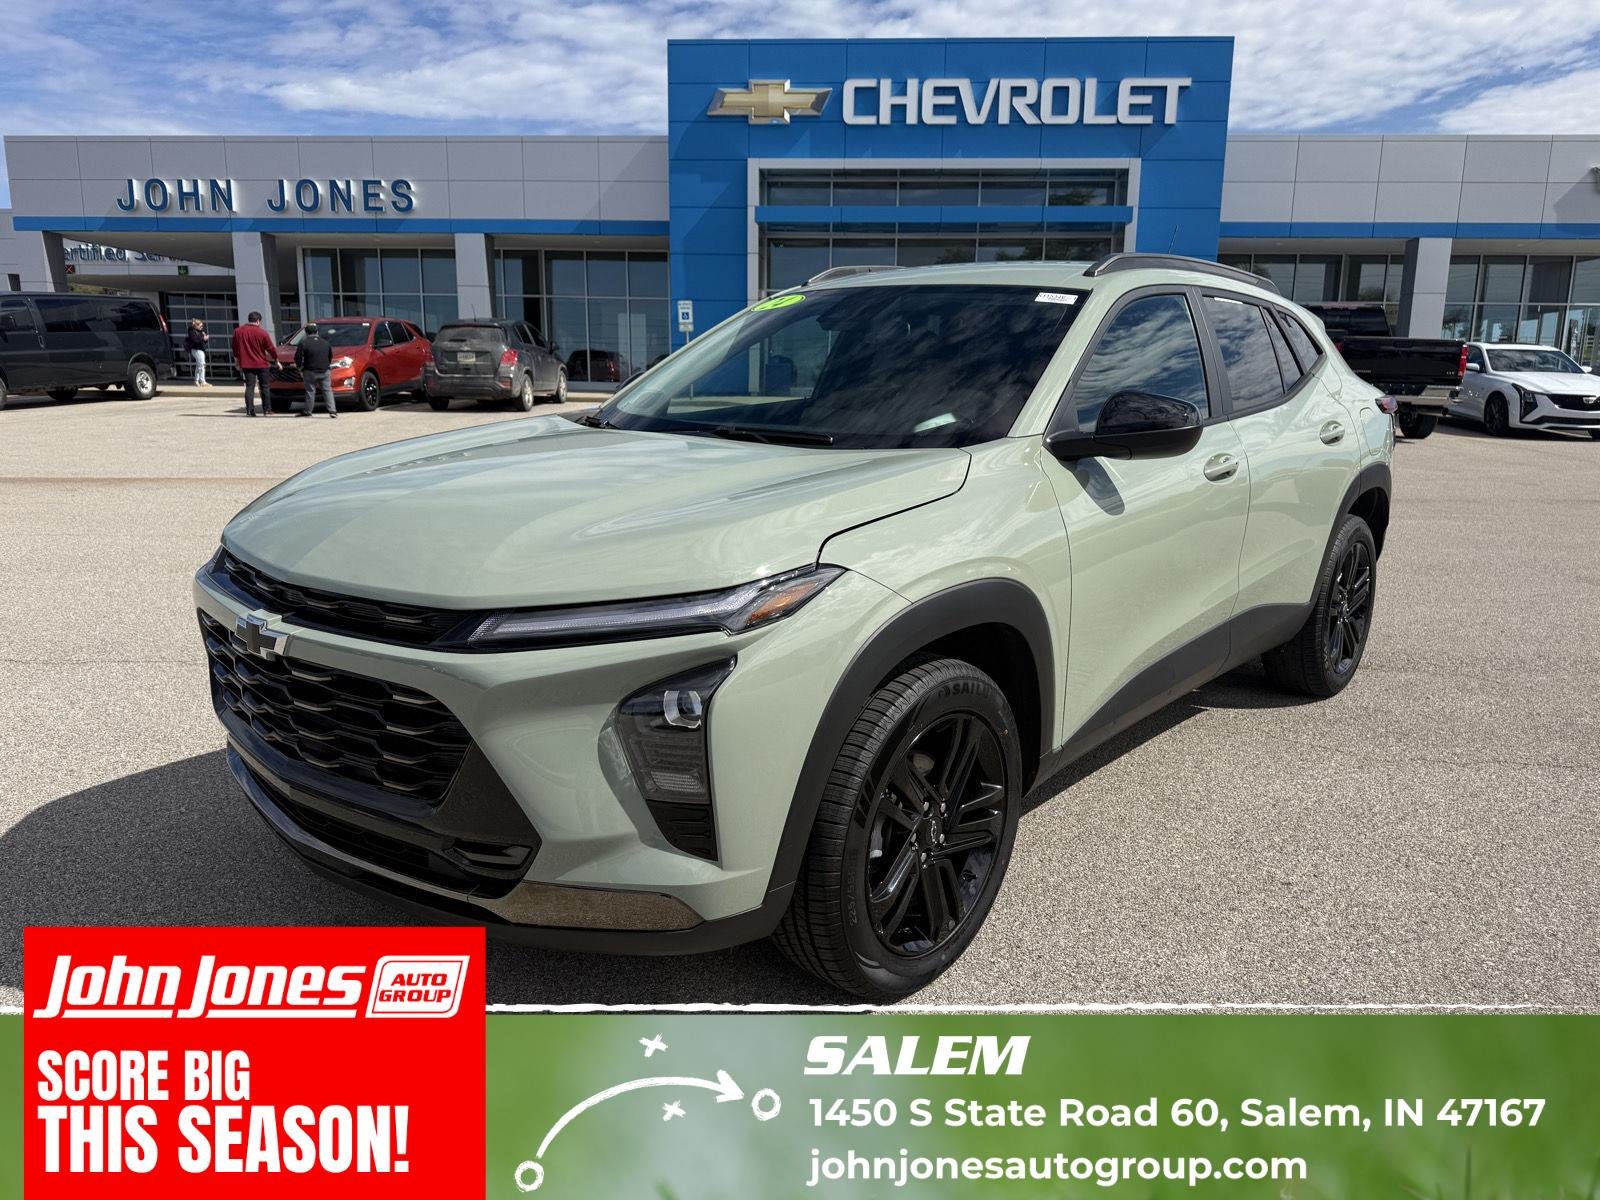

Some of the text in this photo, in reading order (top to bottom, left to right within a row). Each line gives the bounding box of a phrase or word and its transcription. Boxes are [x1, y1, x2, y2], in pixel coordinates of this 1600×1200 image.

[843, 78, 1192, 126] CHEVROLET
[116, 177, 418, 214] JOHN JONES
[63, 244, 128, 262] ertified
